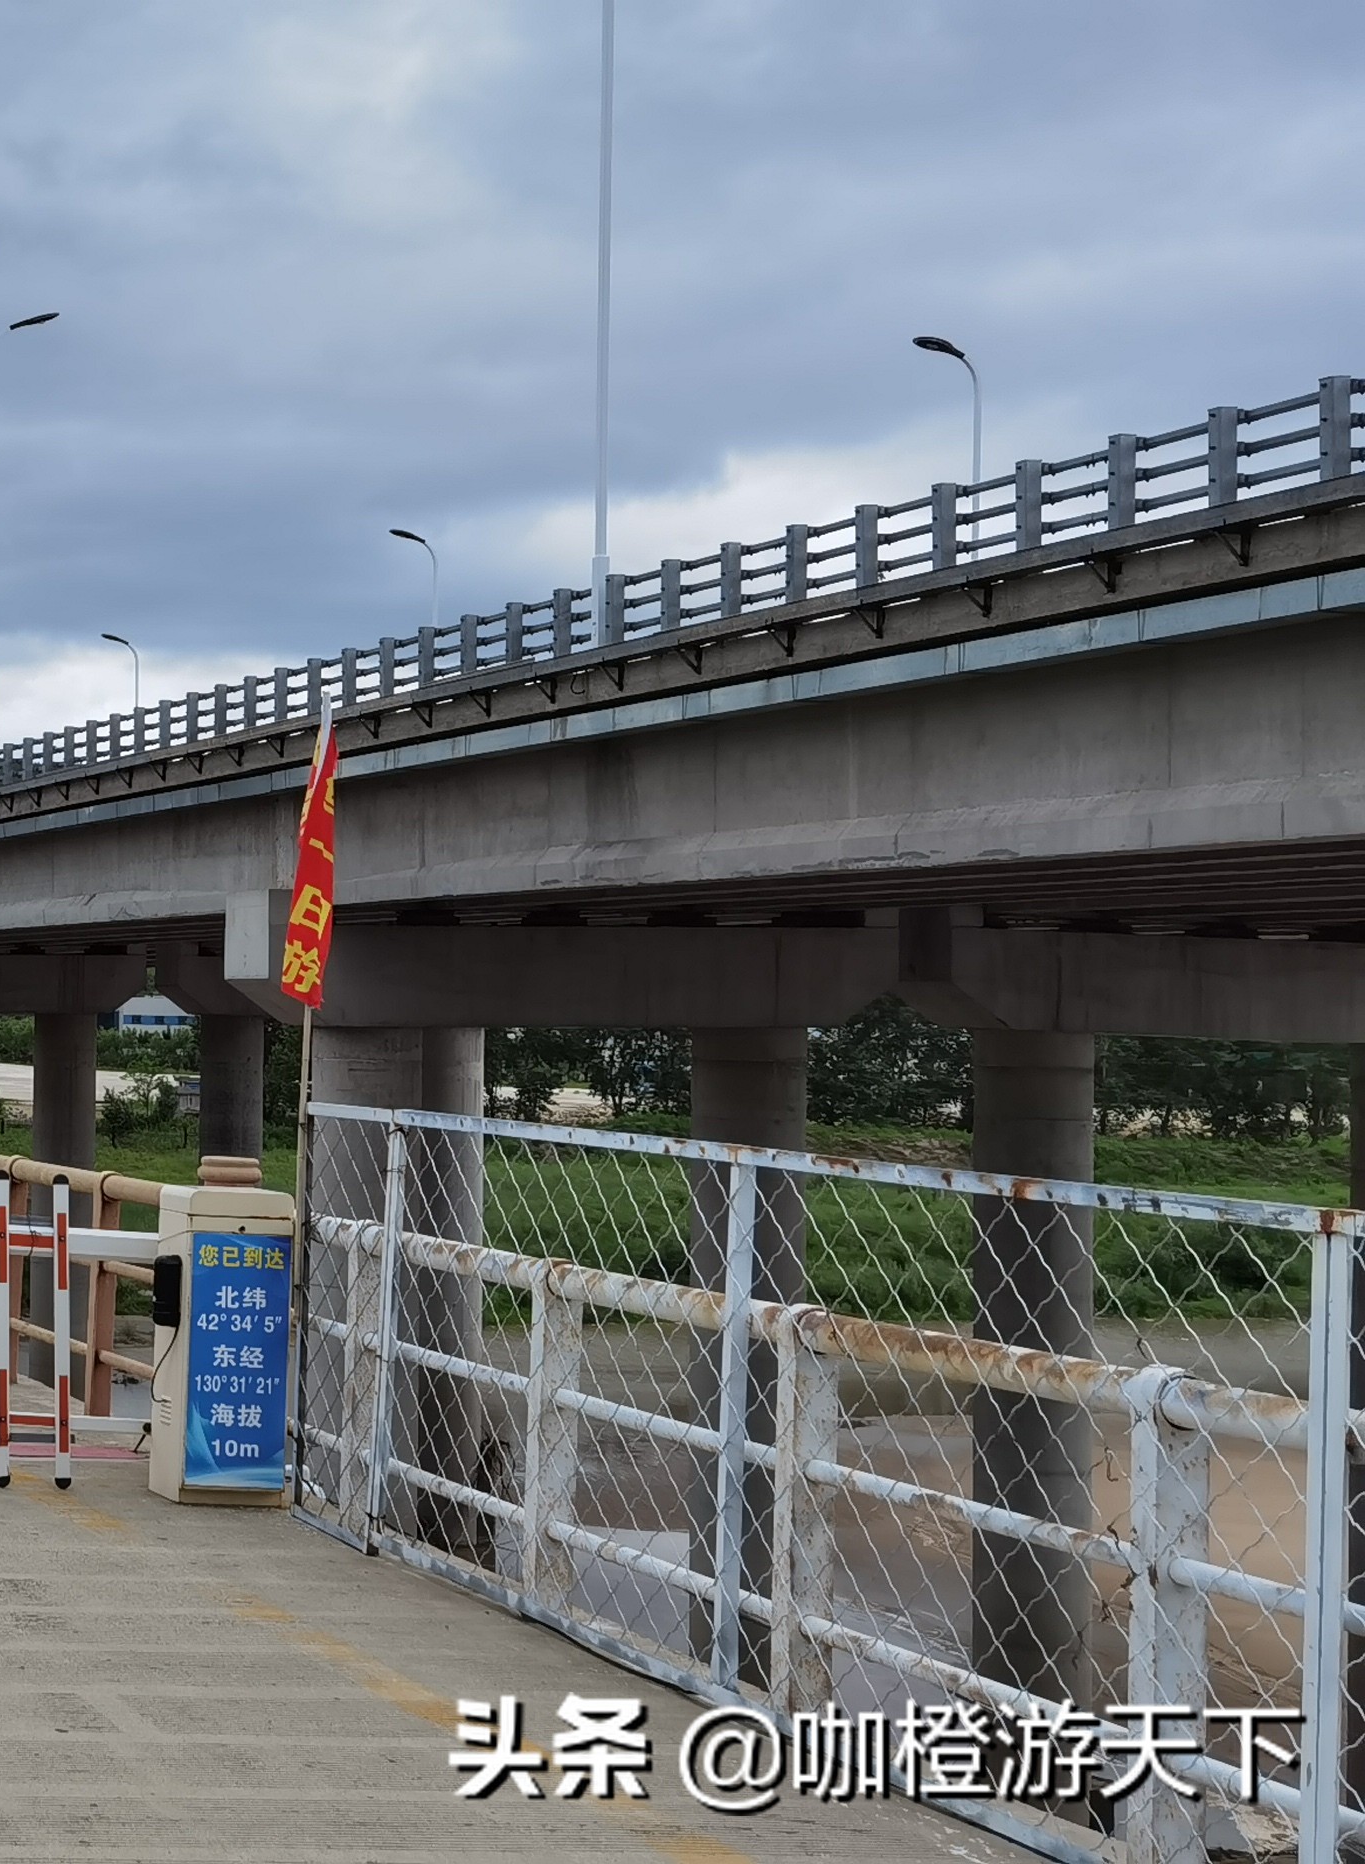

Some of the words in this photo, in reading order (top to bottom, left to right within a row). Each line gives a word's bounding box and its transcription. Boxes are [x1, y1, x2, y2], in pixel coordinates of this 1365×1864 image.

[281, 776, 335, 990] 一日游
[198, 1244, 285, 1270] 您已到达
[214, 1285, 267, 1310] 北纬
[212, 1344, 265, 1369] 东经
[210, 1402, 263, 1428] 海拔
[211, 1438, 260, 1458] 10m
